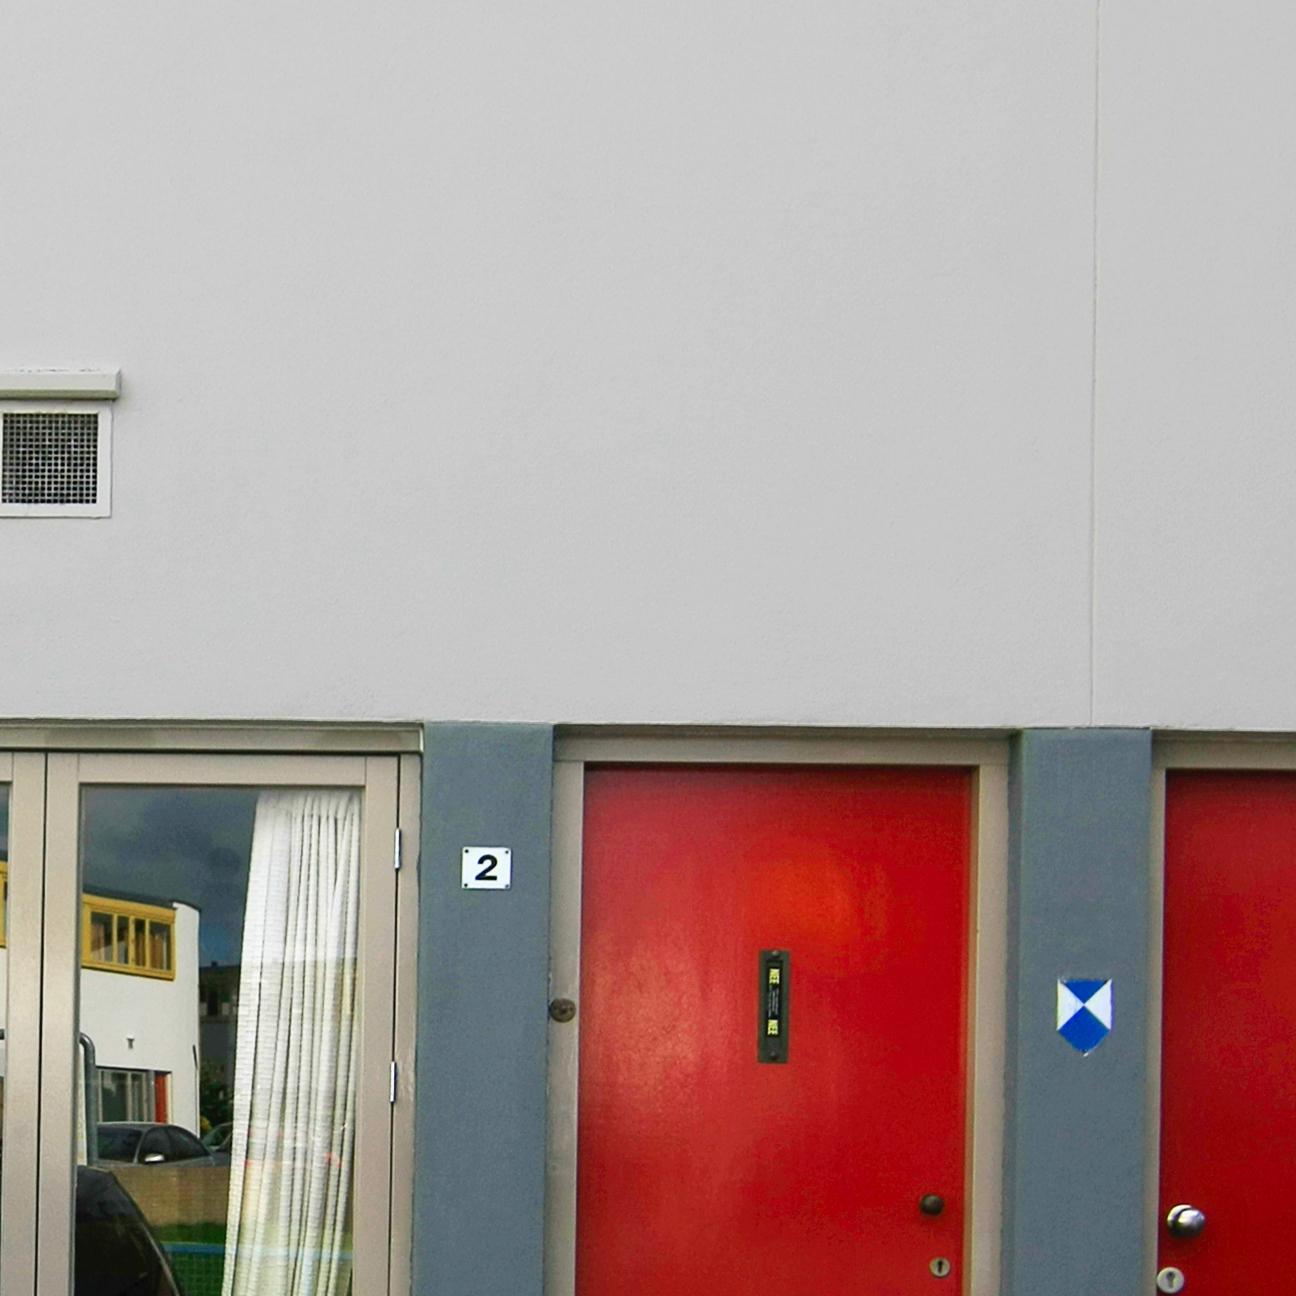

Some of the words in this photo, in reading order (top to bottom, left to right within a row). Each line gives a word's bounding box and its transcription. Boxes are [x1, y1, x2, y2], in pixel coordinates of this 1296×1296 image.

[475, 854, 498, 881] 2
[769, 968, 780, 984] NEE
[767, 1019, 779, 1035] NEE
